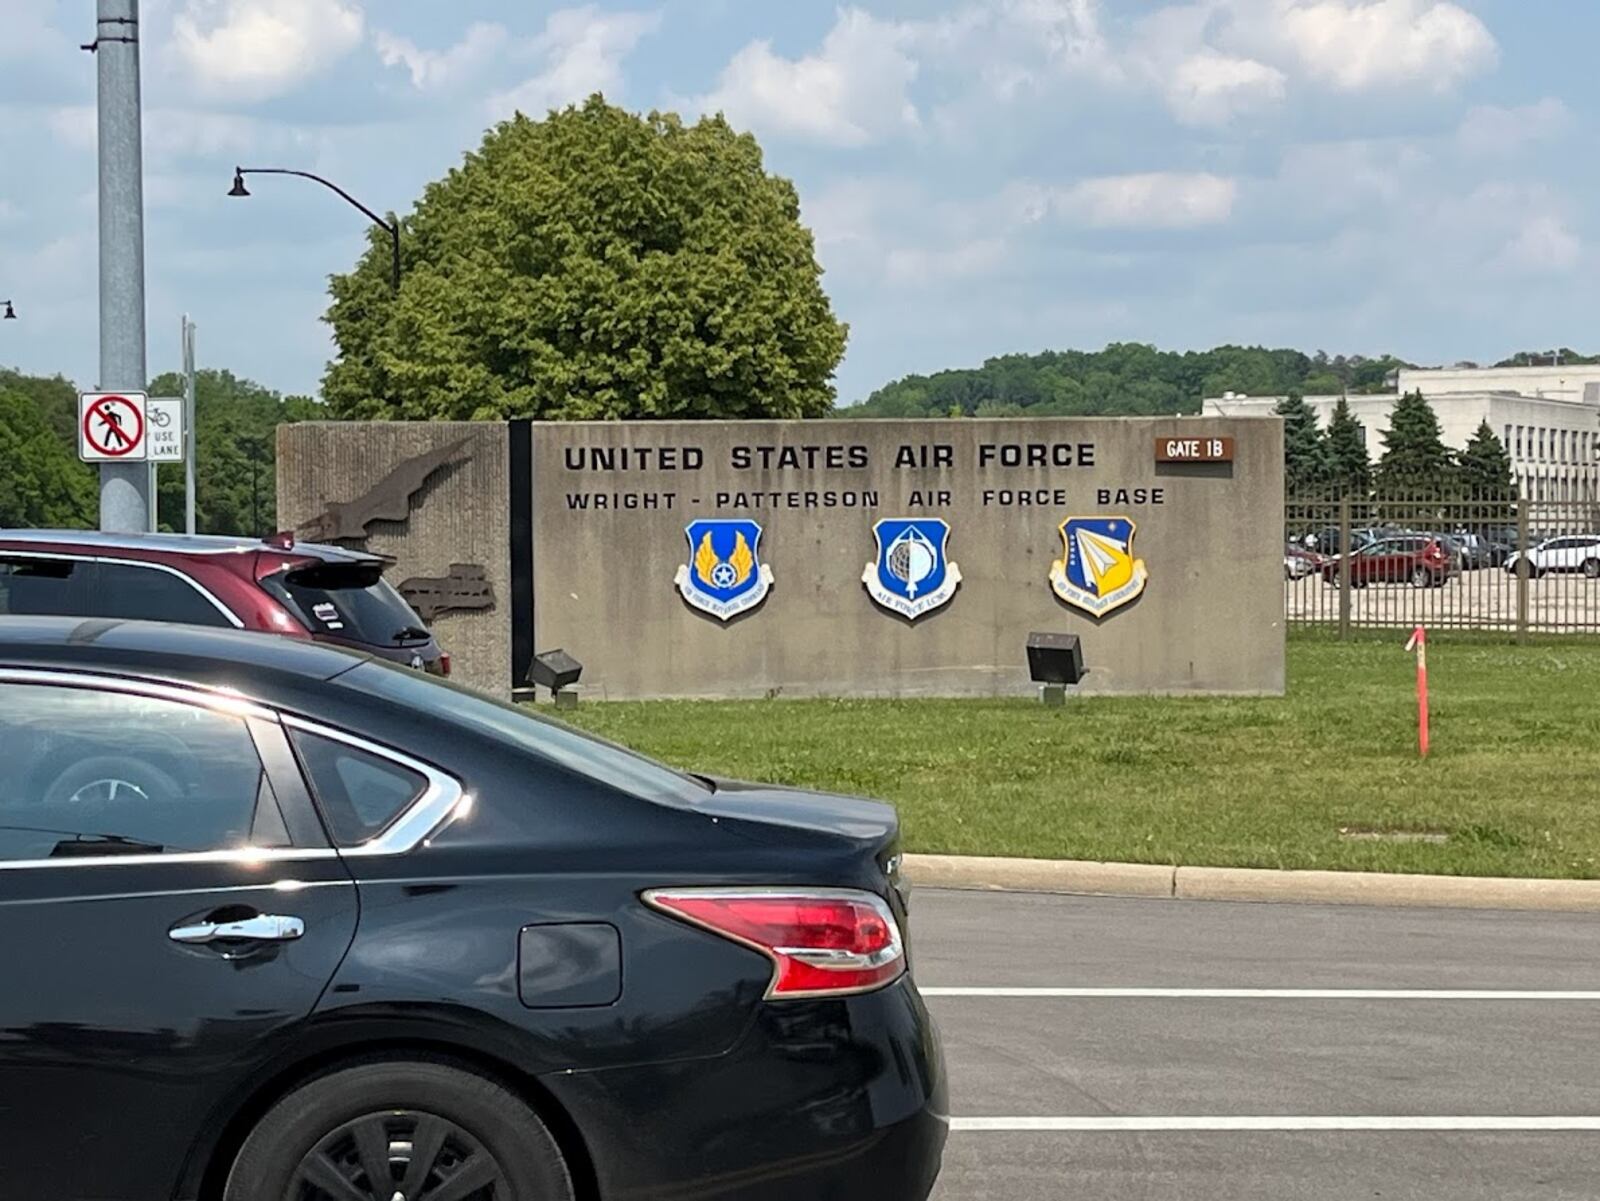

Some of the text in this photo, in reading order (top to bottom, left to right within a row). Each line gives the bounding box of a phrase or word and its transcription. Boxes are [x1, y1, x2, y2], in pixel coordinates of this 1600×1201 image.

[154, 431, 174, 442] USE
[153, 445, 179, 456] LANE
[564, 443, 1096, 471] UNITED STATES AIR FORCE
[1166, 439, 1223, 458] GATE 1B
[565, 492, 676, 510] WRIGHT
[716, 491, 879, 508] PATTERSON
[908, 490, 952, 507] AIR
[983, 489, 1067, 507] FORCE
[1097, 488, 1165, 505] BASE
